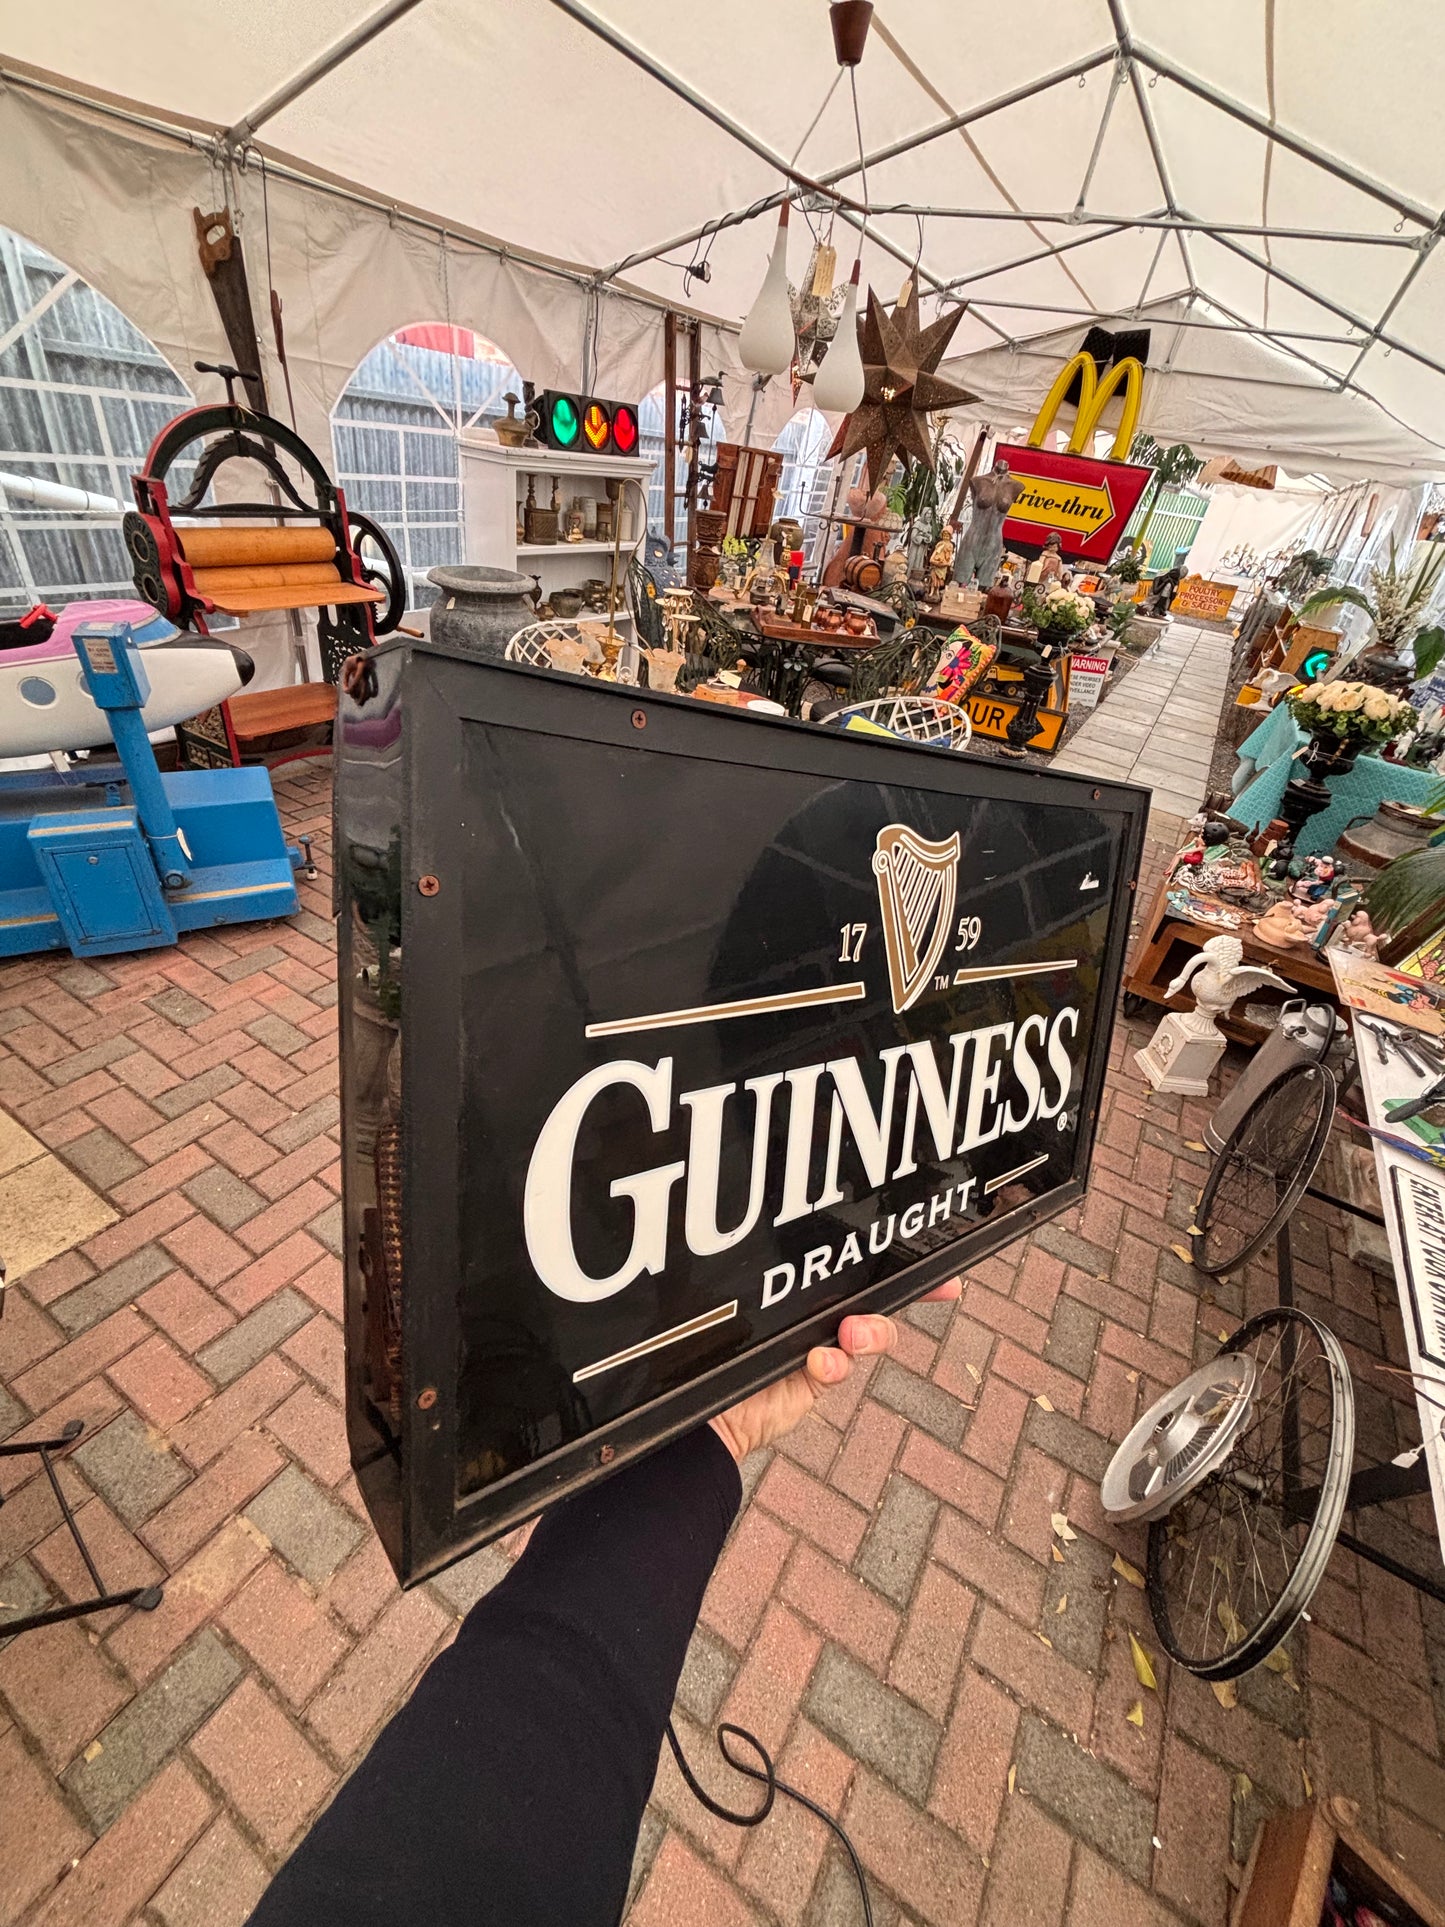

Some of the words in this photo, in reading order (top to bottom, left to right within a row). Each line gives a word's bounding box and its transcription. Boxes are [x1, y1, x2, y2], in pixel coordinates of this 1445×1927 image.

[1180, 592, 1229, 606] PROCESSORS
[1190, 585, 1222, 597] POULTRY
[1191, 601, 1218, 612] SALES
[838, 922, 867, 963] 17
[954, 916, 982, 951] 59
[523, 1007, 1079, 1302] GUINNESS
[1410, 1178, 1445, 1225] ENTER
[760, 1176, 976, 1309] DRAUGHT
